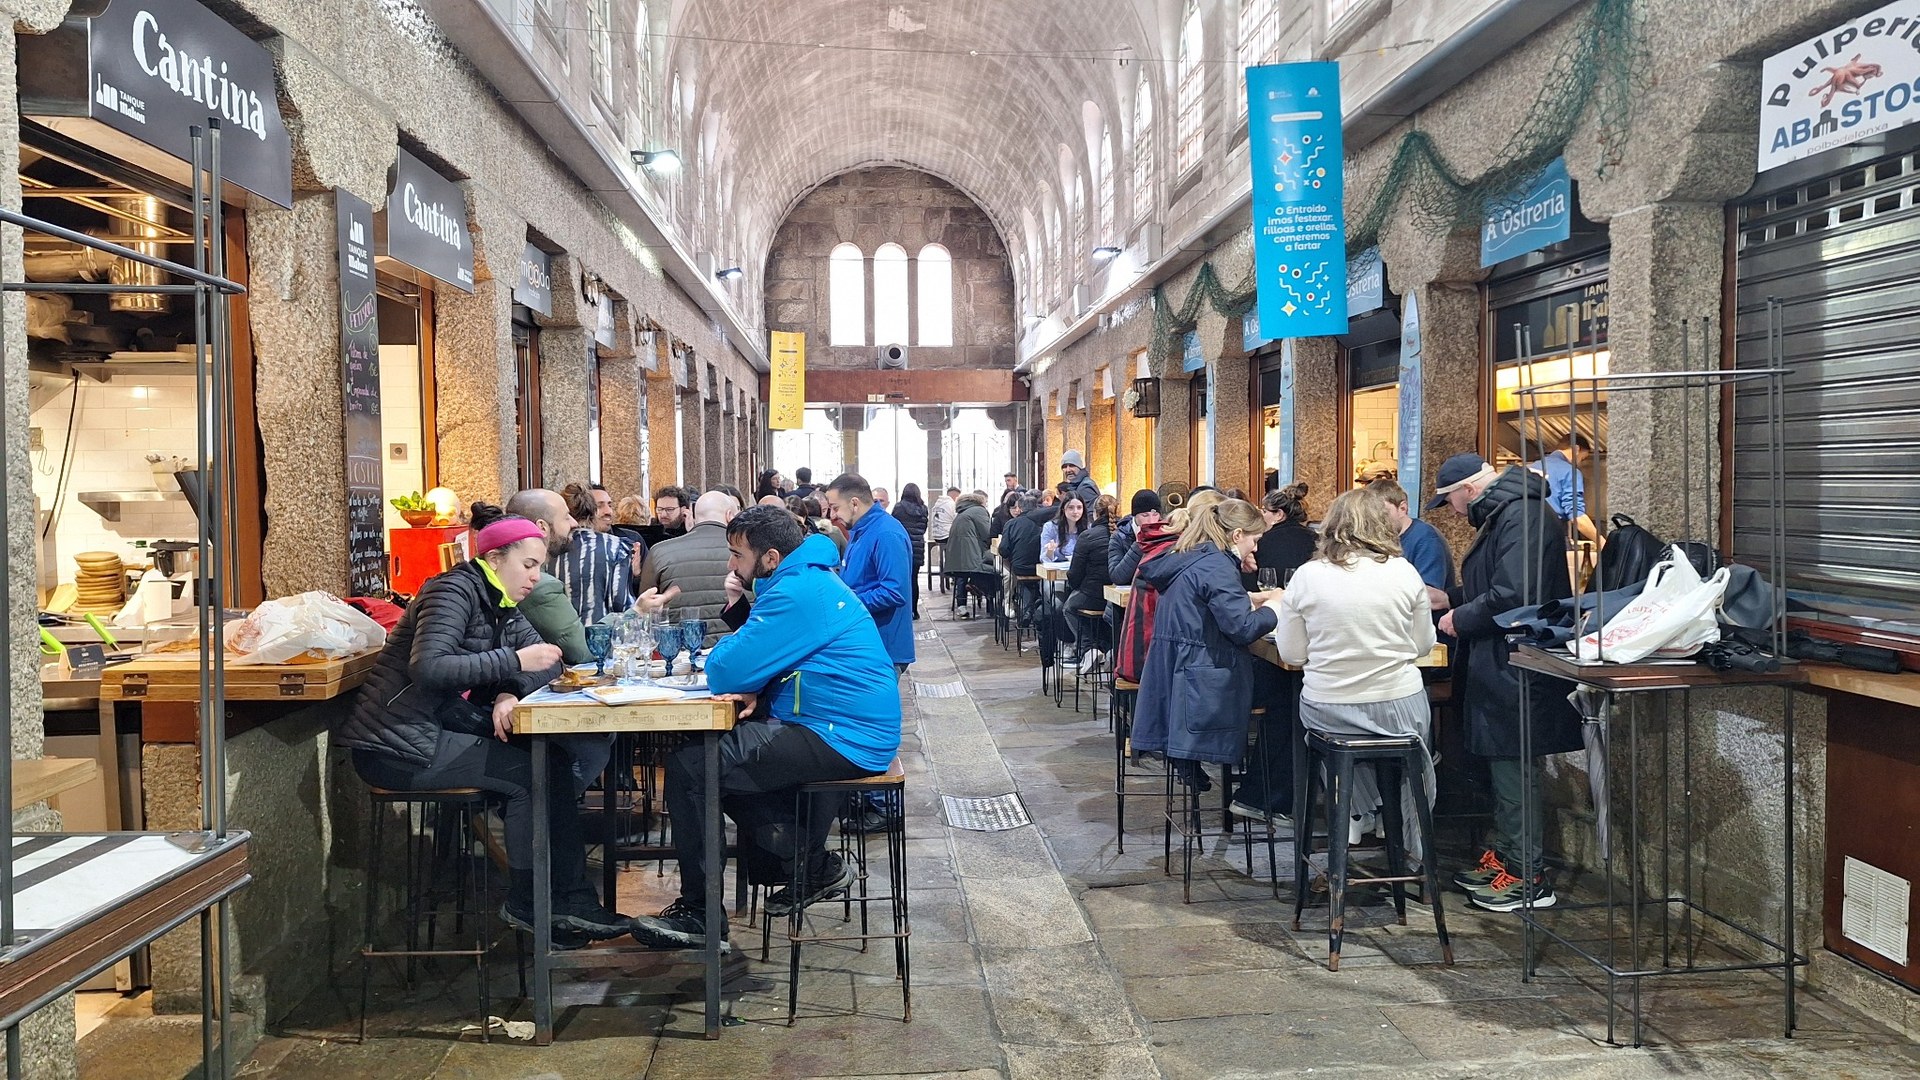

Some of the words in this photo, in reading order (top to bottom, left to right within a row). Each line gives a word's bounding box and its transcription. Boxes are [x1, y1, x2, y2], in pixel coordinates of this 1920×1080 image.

[133, 11, 266, 141] Cantina
[119, 90, 145, 111] TANQUE
[119, 100, 146, 124] Mahou
[404, 183, 461, 251] Cantina
[1275, 206, 1284, 215] O
[1286, 204, 1327, 214] Entroido
[1485, 217, 1498, 242] A
[1501, 189, 1565, 235] Ostrería
[1263, 225, 1295, 235] filloas
[1305, 222, 1338, 232] orellas,
[1268, 217, 1293, 225] imos
[1273, 233, 1330, 243] comeremos
[1294, 242, 1321, 250] fartar
[348, 243, 368, 259] TANQUE
